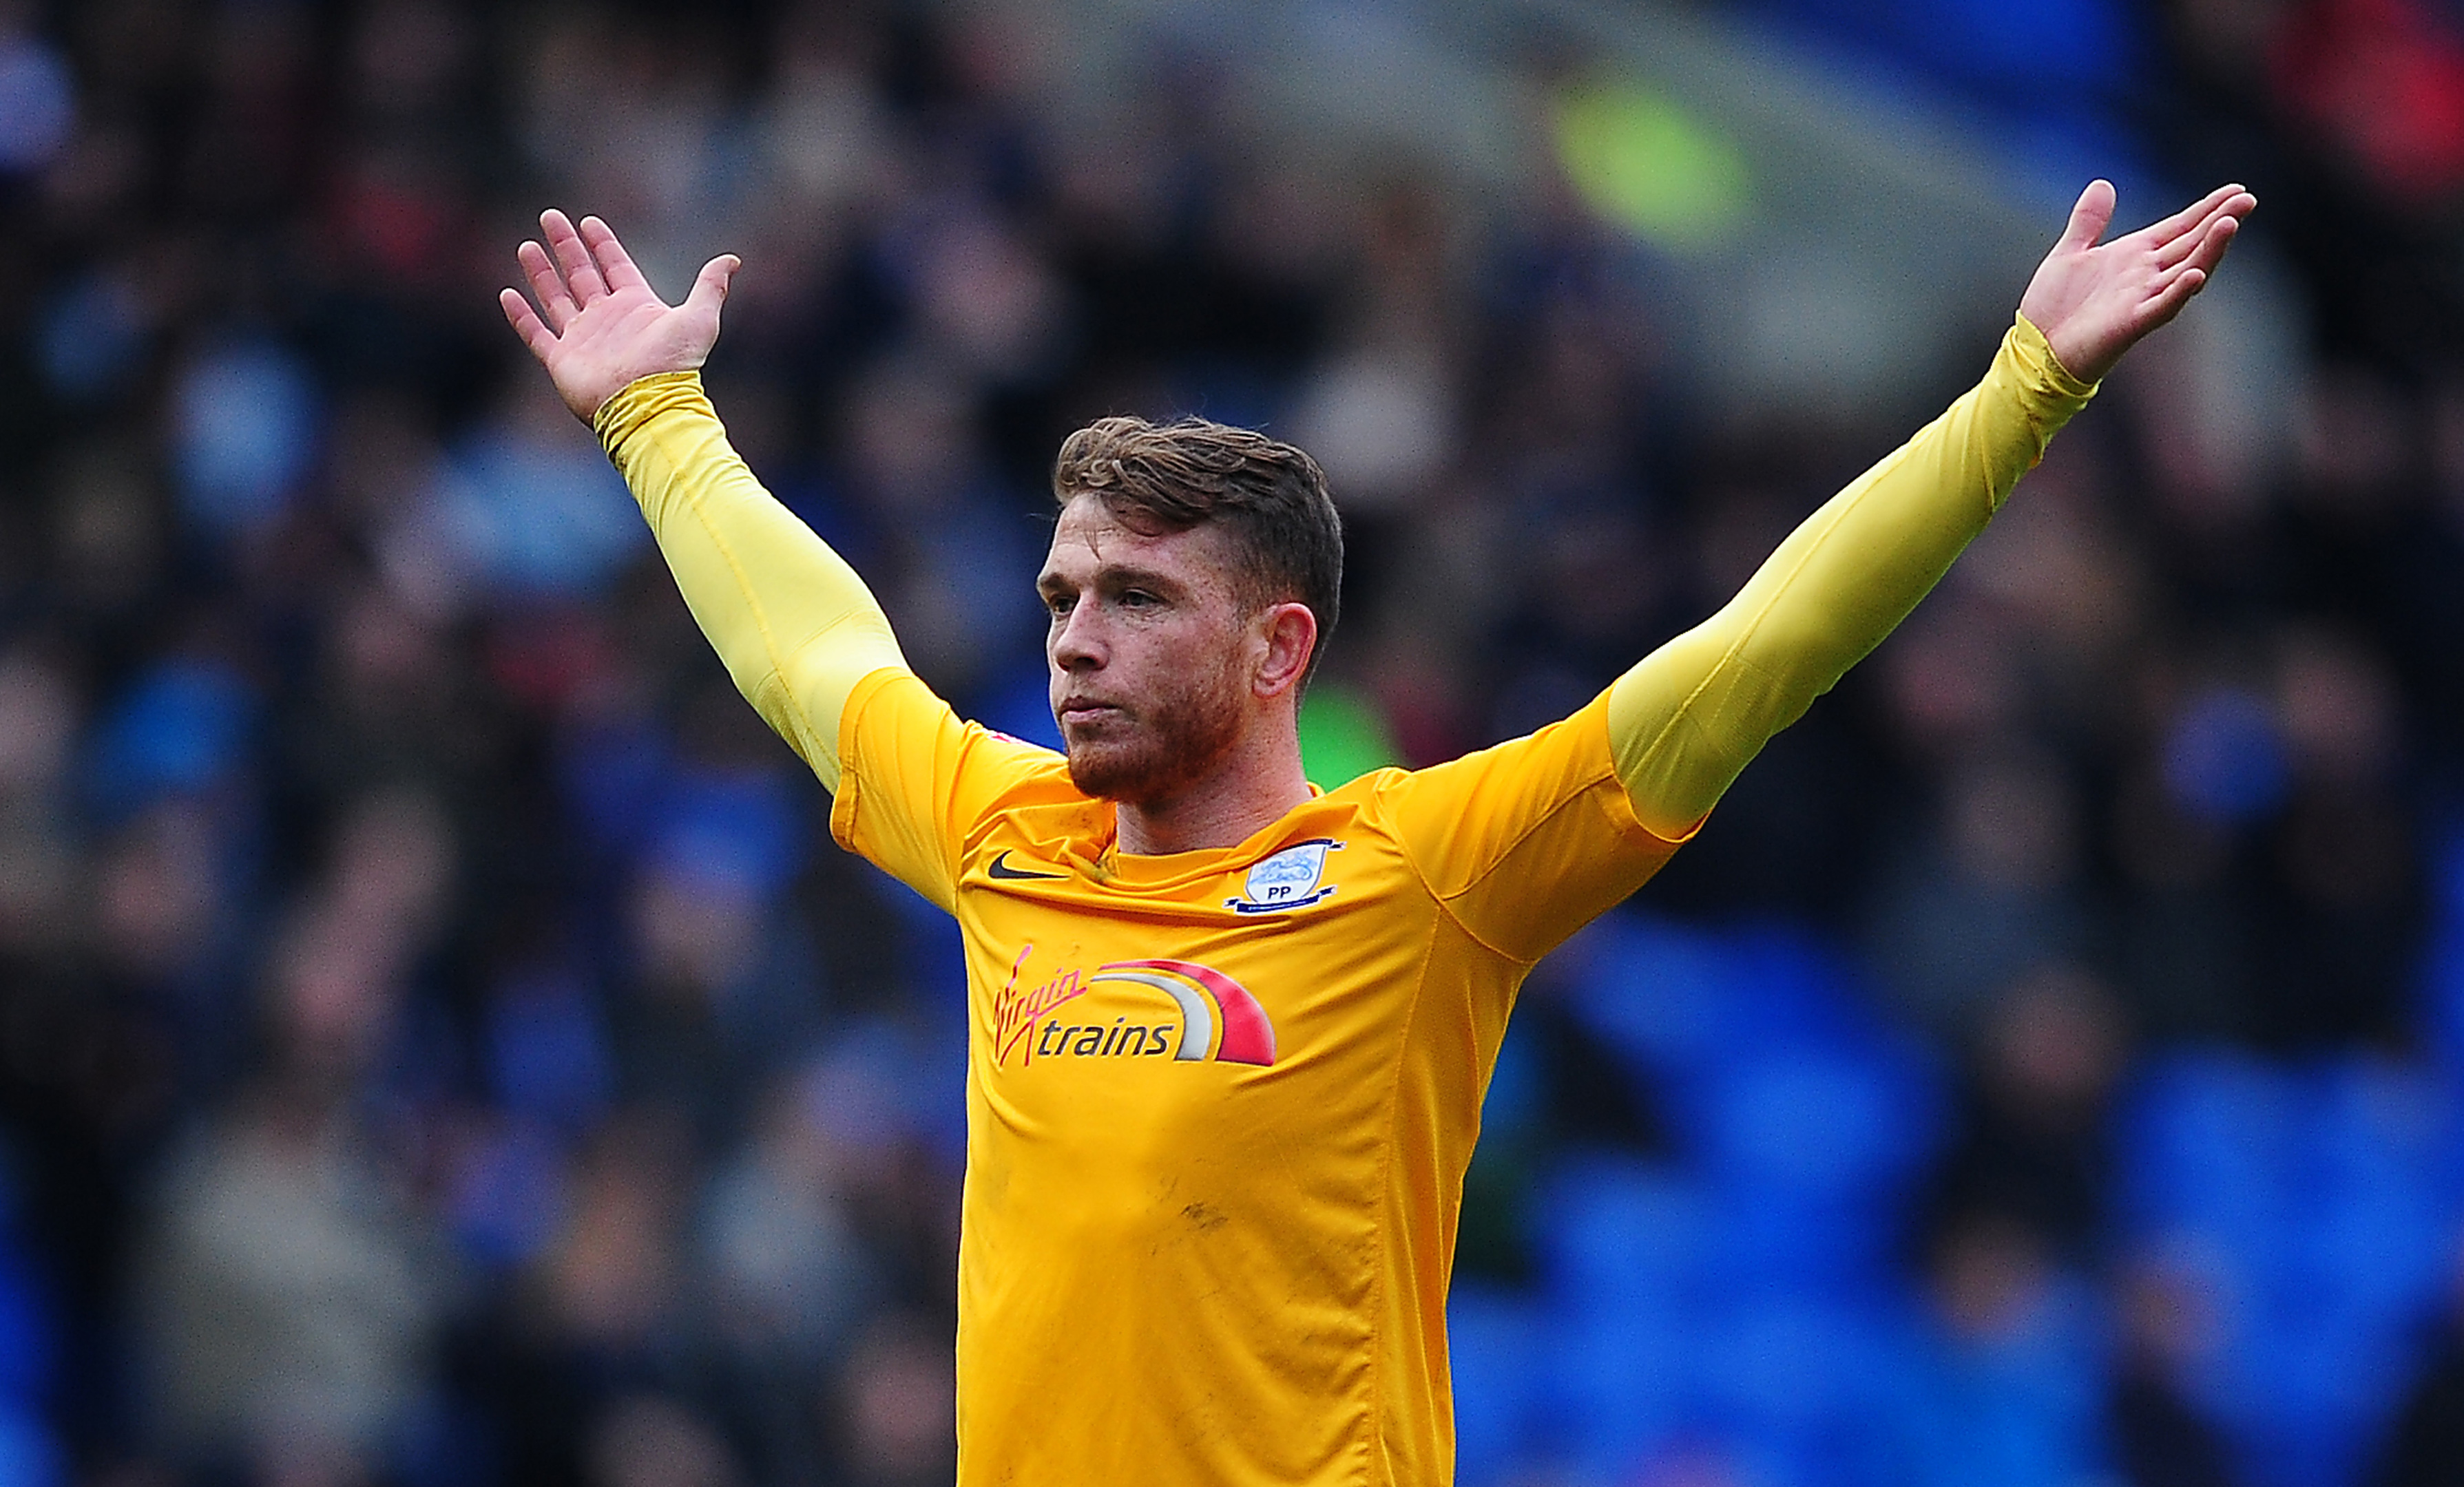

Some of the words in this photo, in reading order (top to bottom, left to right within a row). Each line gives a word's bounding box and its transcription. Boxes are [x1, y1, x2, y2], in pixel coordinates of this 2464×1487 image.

[1268, 886, 1291, 899] PP
[994, 945, 1087, 1066] Virgin
[1038, 1017, 1173, 1056] trains
